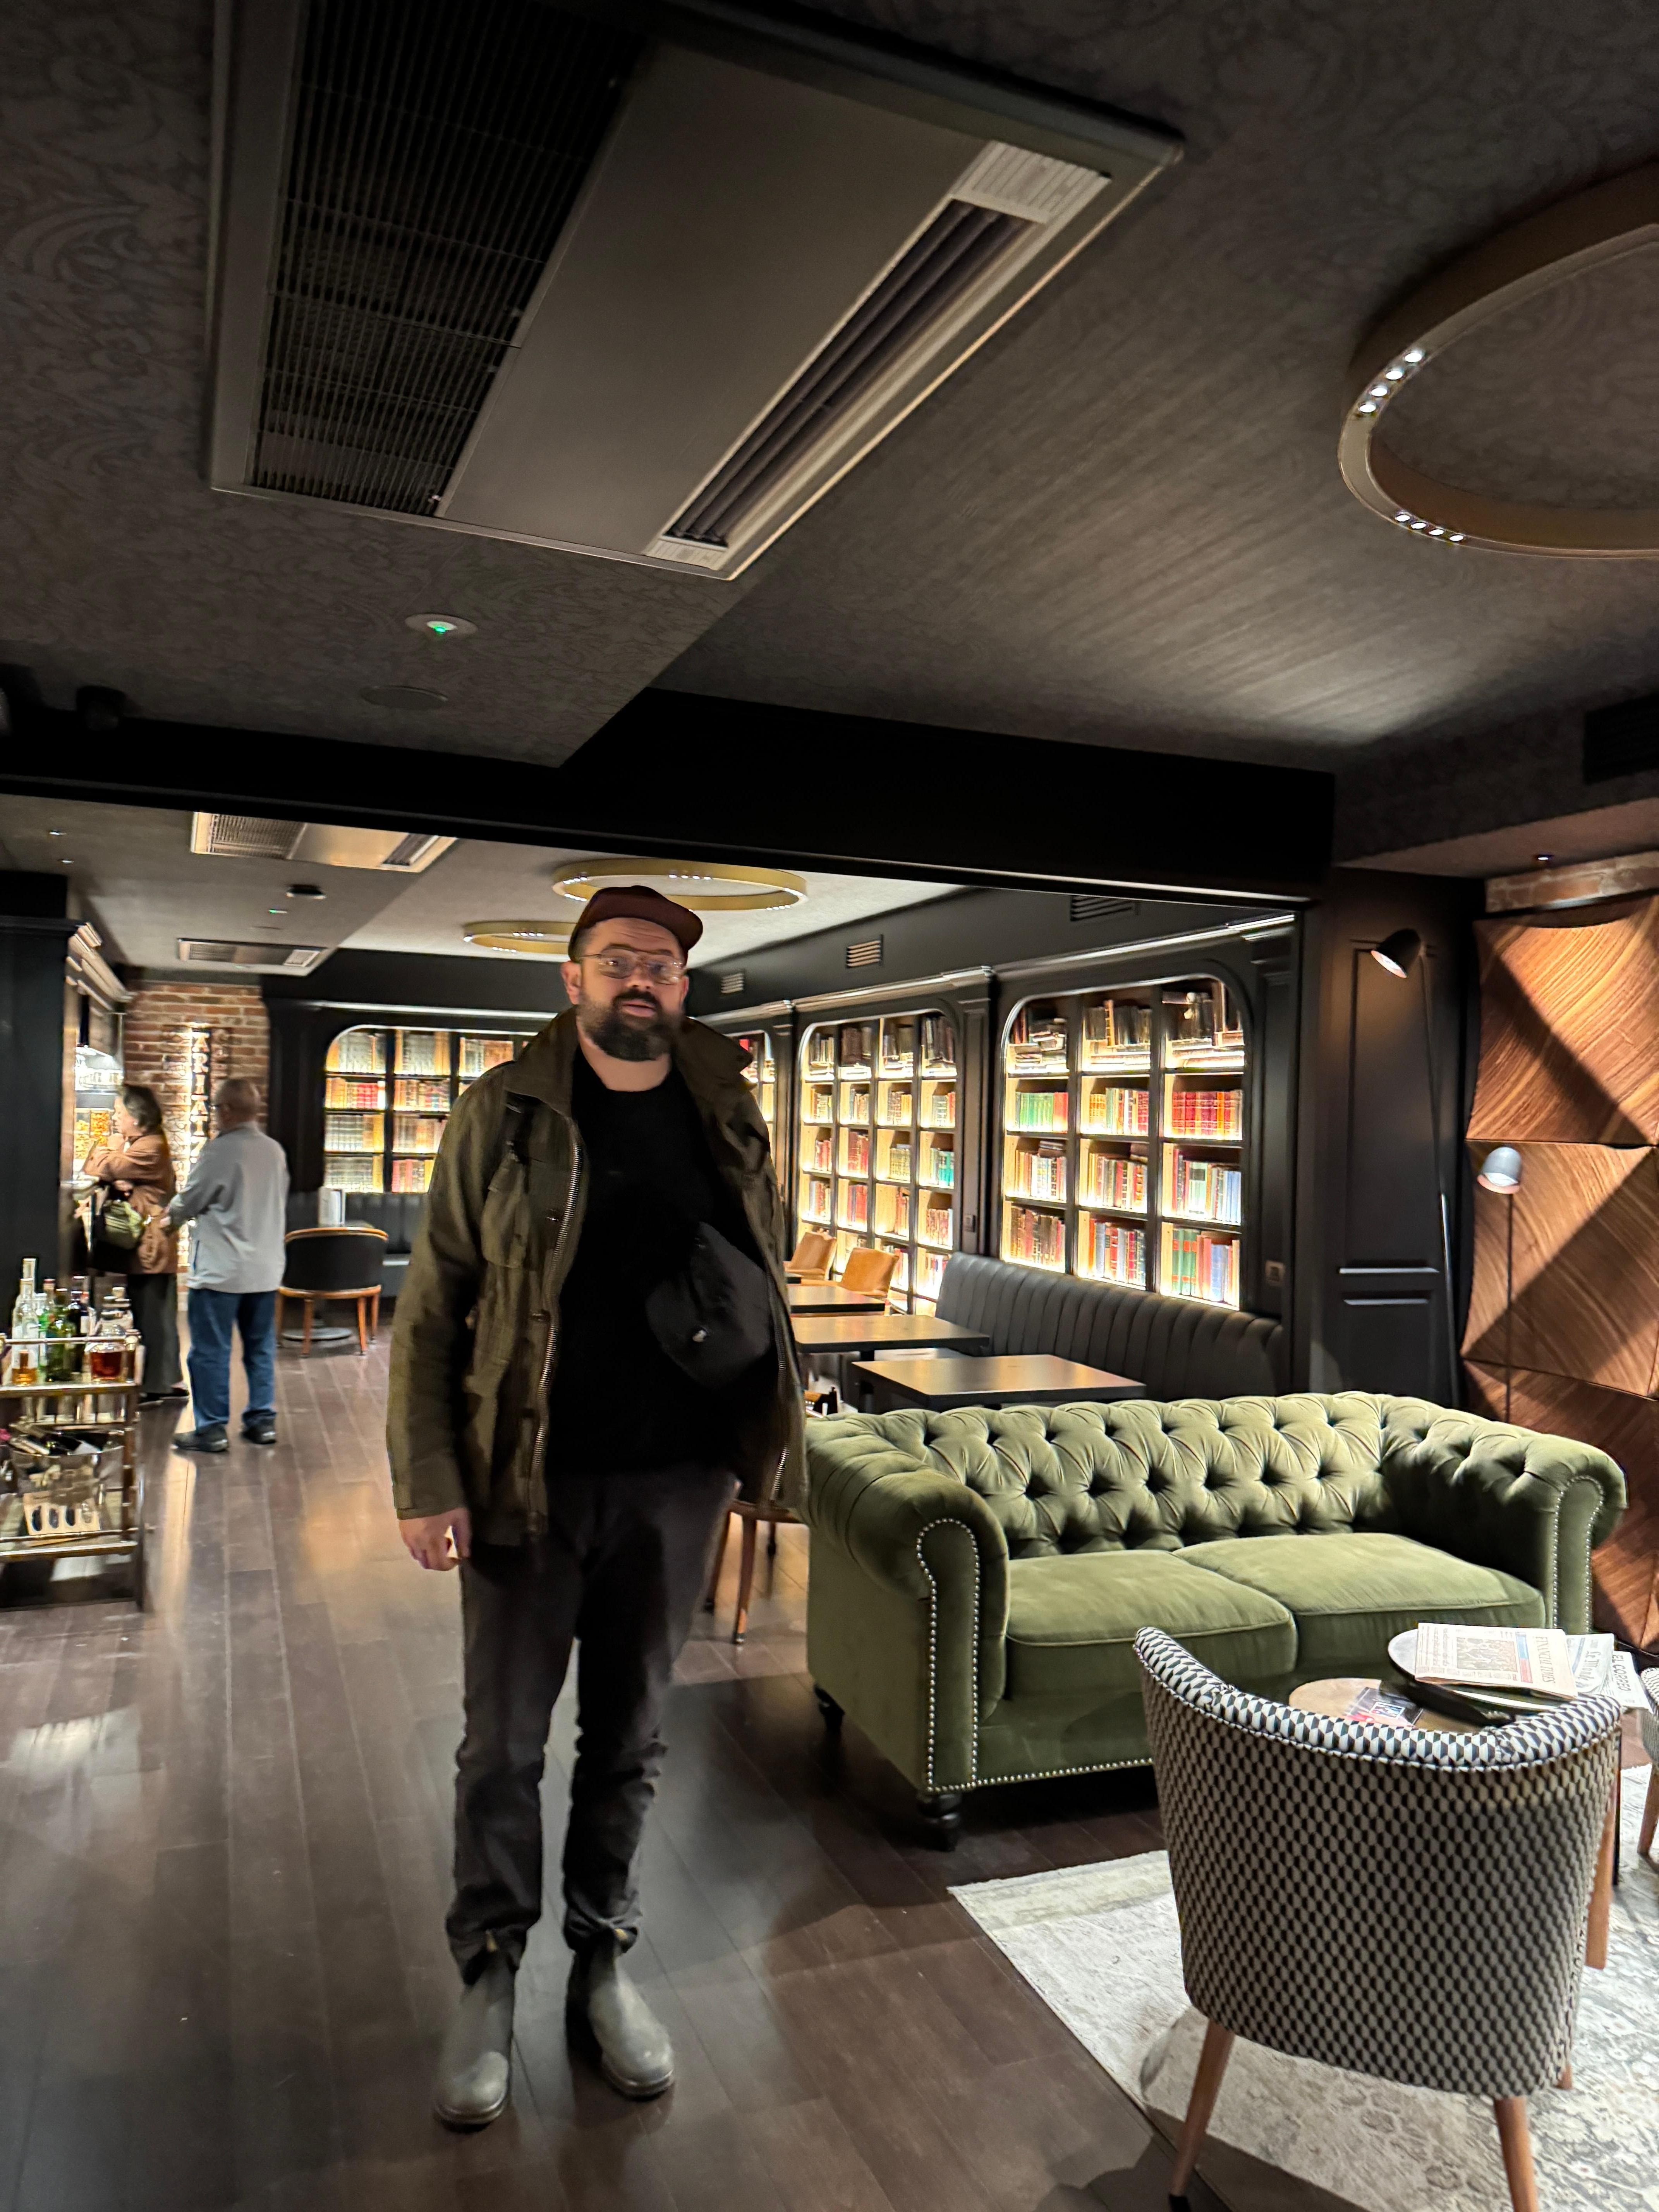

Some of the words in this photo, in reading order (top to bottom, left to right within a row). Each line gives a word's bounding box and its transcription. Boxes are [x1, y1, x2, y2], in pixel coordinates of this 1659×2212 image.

[190, 1032, 210, 1163] ARIATZ
[1612, 1655, 1624, 1663] EL
[1541, 1666, 1555, 1683] TIMES
[1578, 1660, 1599, 1681] Monde
[1613, 1664, 1631, 1692] CORREO
